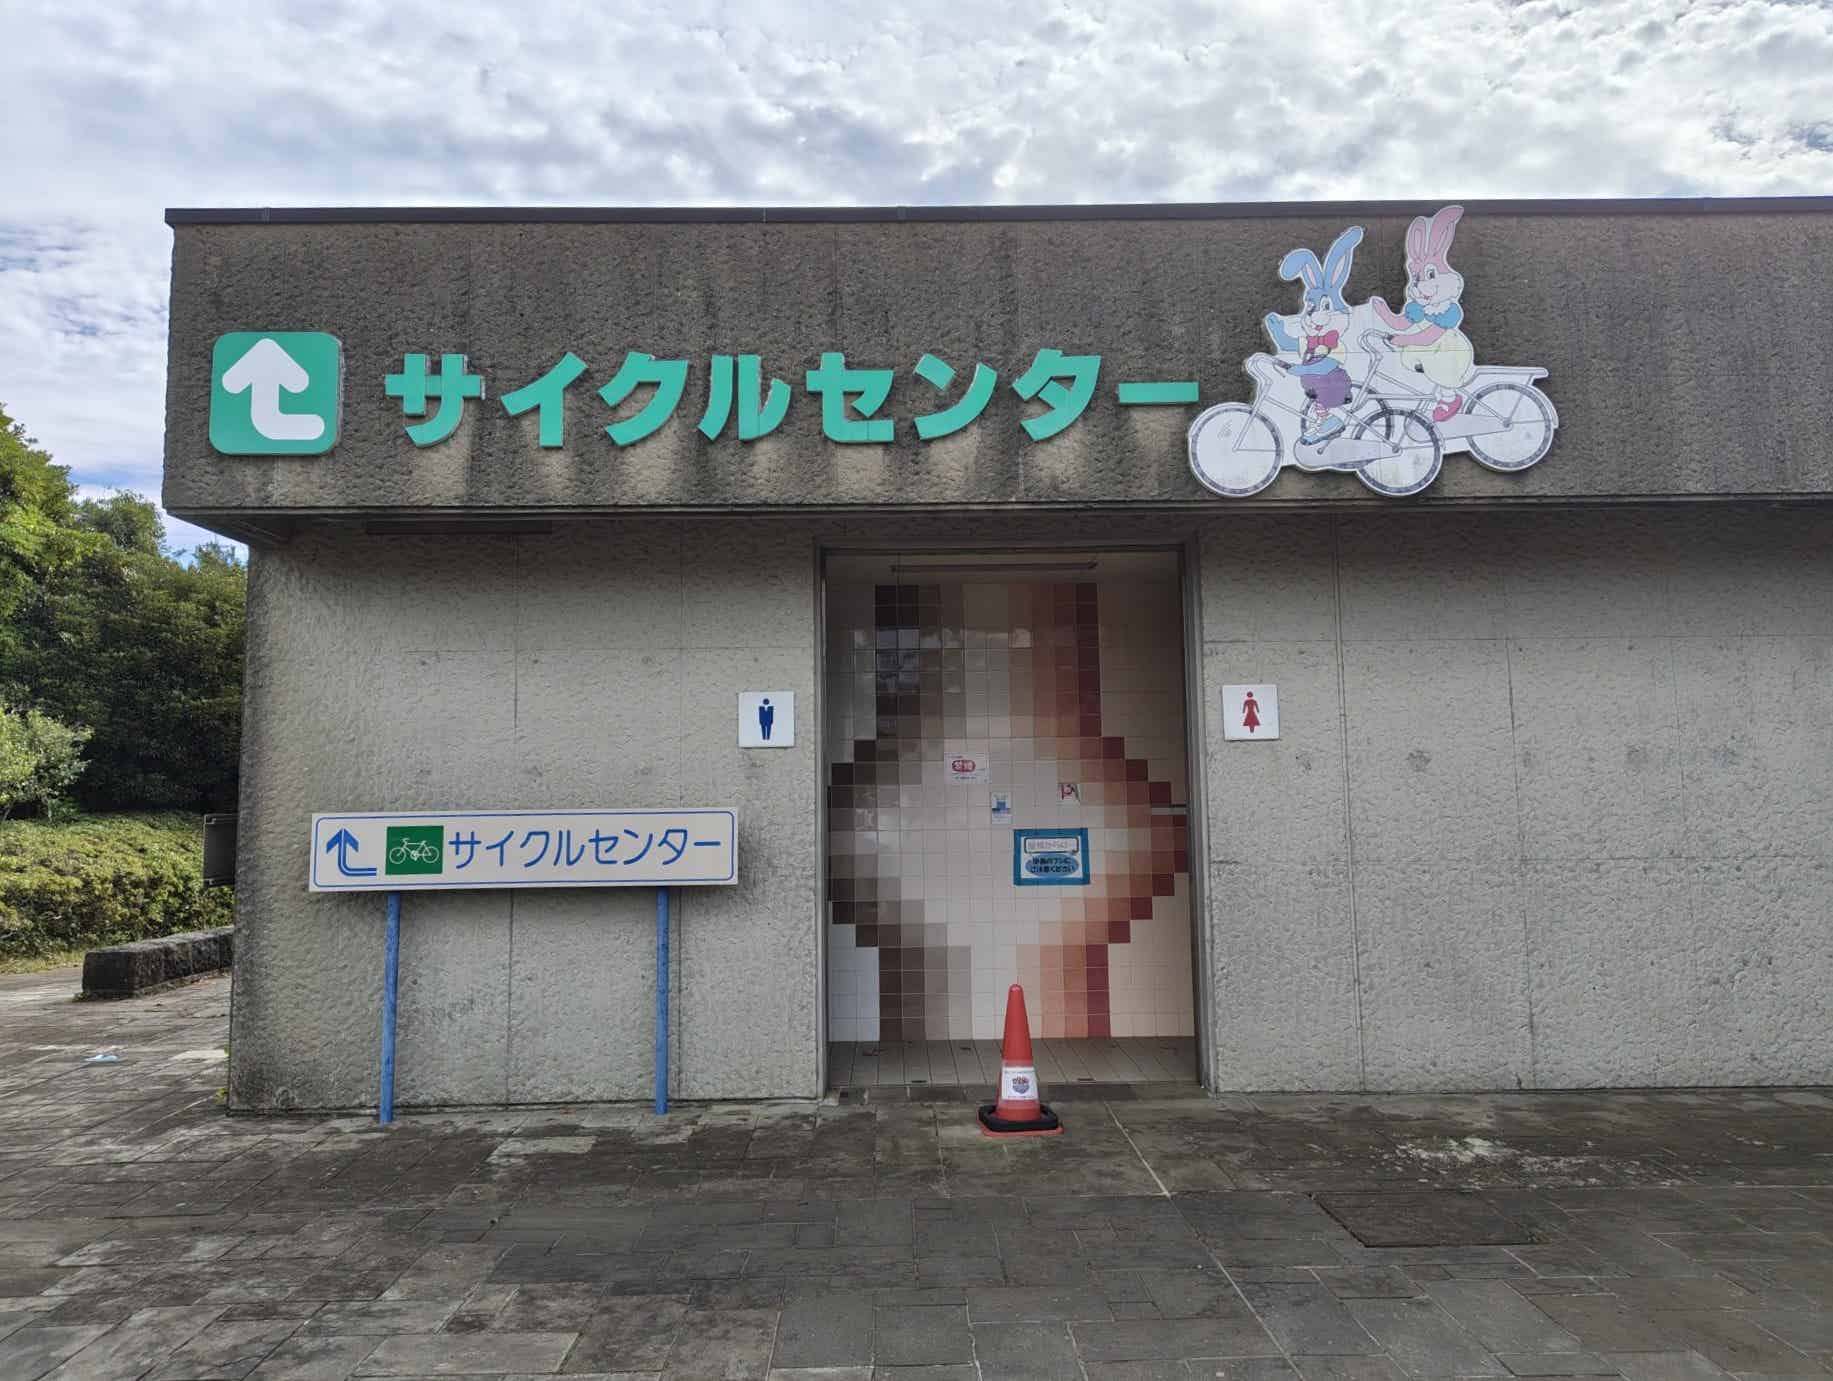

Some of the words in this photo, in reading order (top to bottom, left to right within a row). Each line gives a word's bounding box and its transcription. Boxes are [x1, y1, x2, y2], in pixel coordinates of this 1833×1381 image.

[385, 348, 1199, 448] サイクルセンター
[449, 828, 721, 869] サイクルセンター
